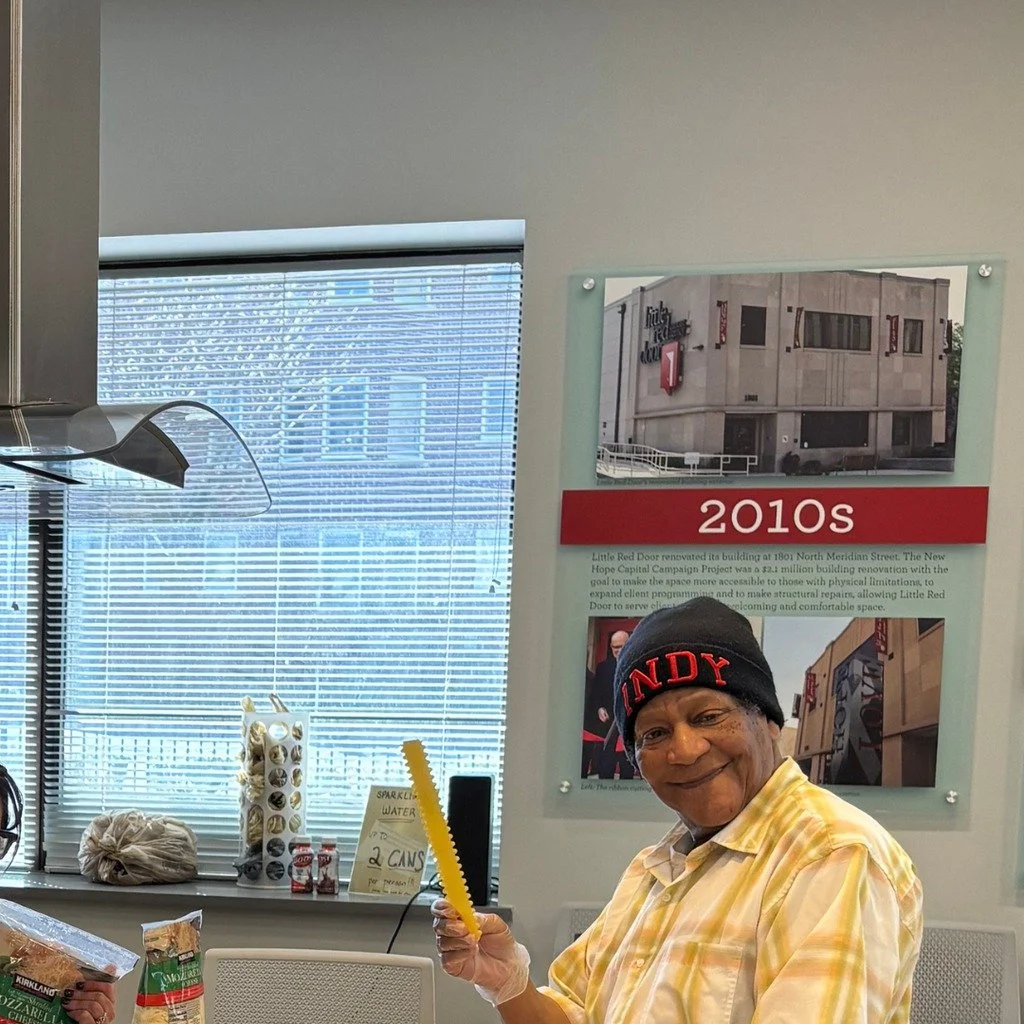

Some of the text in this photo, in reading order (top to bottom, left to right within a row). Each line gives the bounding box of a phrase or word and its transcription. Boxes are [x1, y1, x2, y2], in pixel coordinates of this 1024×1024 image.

[698, 498, 854, 534] 2010s
[592, 552, 615, 562] Little
[617, 552, 634, 562] Red
[637, 552, 658, 562] Door
[661, 552, 706, 562] renovated
[708, 552, 720, 562] its
[722, 552, 760, 563] building
[762, 553, 772, 562] at
[796, 552, 824, 562] North
[826, 552, 868, 562] Meridian
[903, 552, 920, 562] The
[924, 552, 946, 562] New
[592, 565, 616, 576] Hope
[618, 565, 650, 575] Capital
[652, 565, 698, 576] Campaign
[702, 565, 732, 576] Project
[781, 565, 814, 574] million
[816, 565, 854, 576] building
[858, 566, 908, 574] renovation
[910, 565, 931, 574] with
[934, 565, 948, 574] the
[590, 577, 609, 587] goal
[612, 578, 620, 586] to
[623, 578, 646, 586] make
[649, 578, 664, 586] the
[666, 579, 691, 588] space
[719, 578, 764, 586] accessible
[768, 578, 776, 586] to
[779, 578, 803, 586] those
[806, 578, 826, 586] with
[828, 578, 866, 588] physical
[926, 578, 934, 586] to
[590, 590, 622, 600] expand
[624, 589, 648, 598] client
[716, 589, 733, 598] and
[736, 590, 744, 598] to
[748, 589, 771, 598] make
[774, 589, 818, 598] structural
[858, 589, 896, 600] allowing
[900, 589, 924, 598] Little
[928, 589, 946, 598] Red
[590, 602, 610, 610] Door
[614, 602, 622, 610] to
[780, 602, 796, 610] and
[799, 601, 854, 611] comfortable
[622, 650, 730, 716] INDY
[376, 790, 417, 800] SPARKLI
[382, 806, 416, 818] WATER
[368, 846, 424, 872] 2 CANS
[16, 976, 56, 997] KIRKLAND
